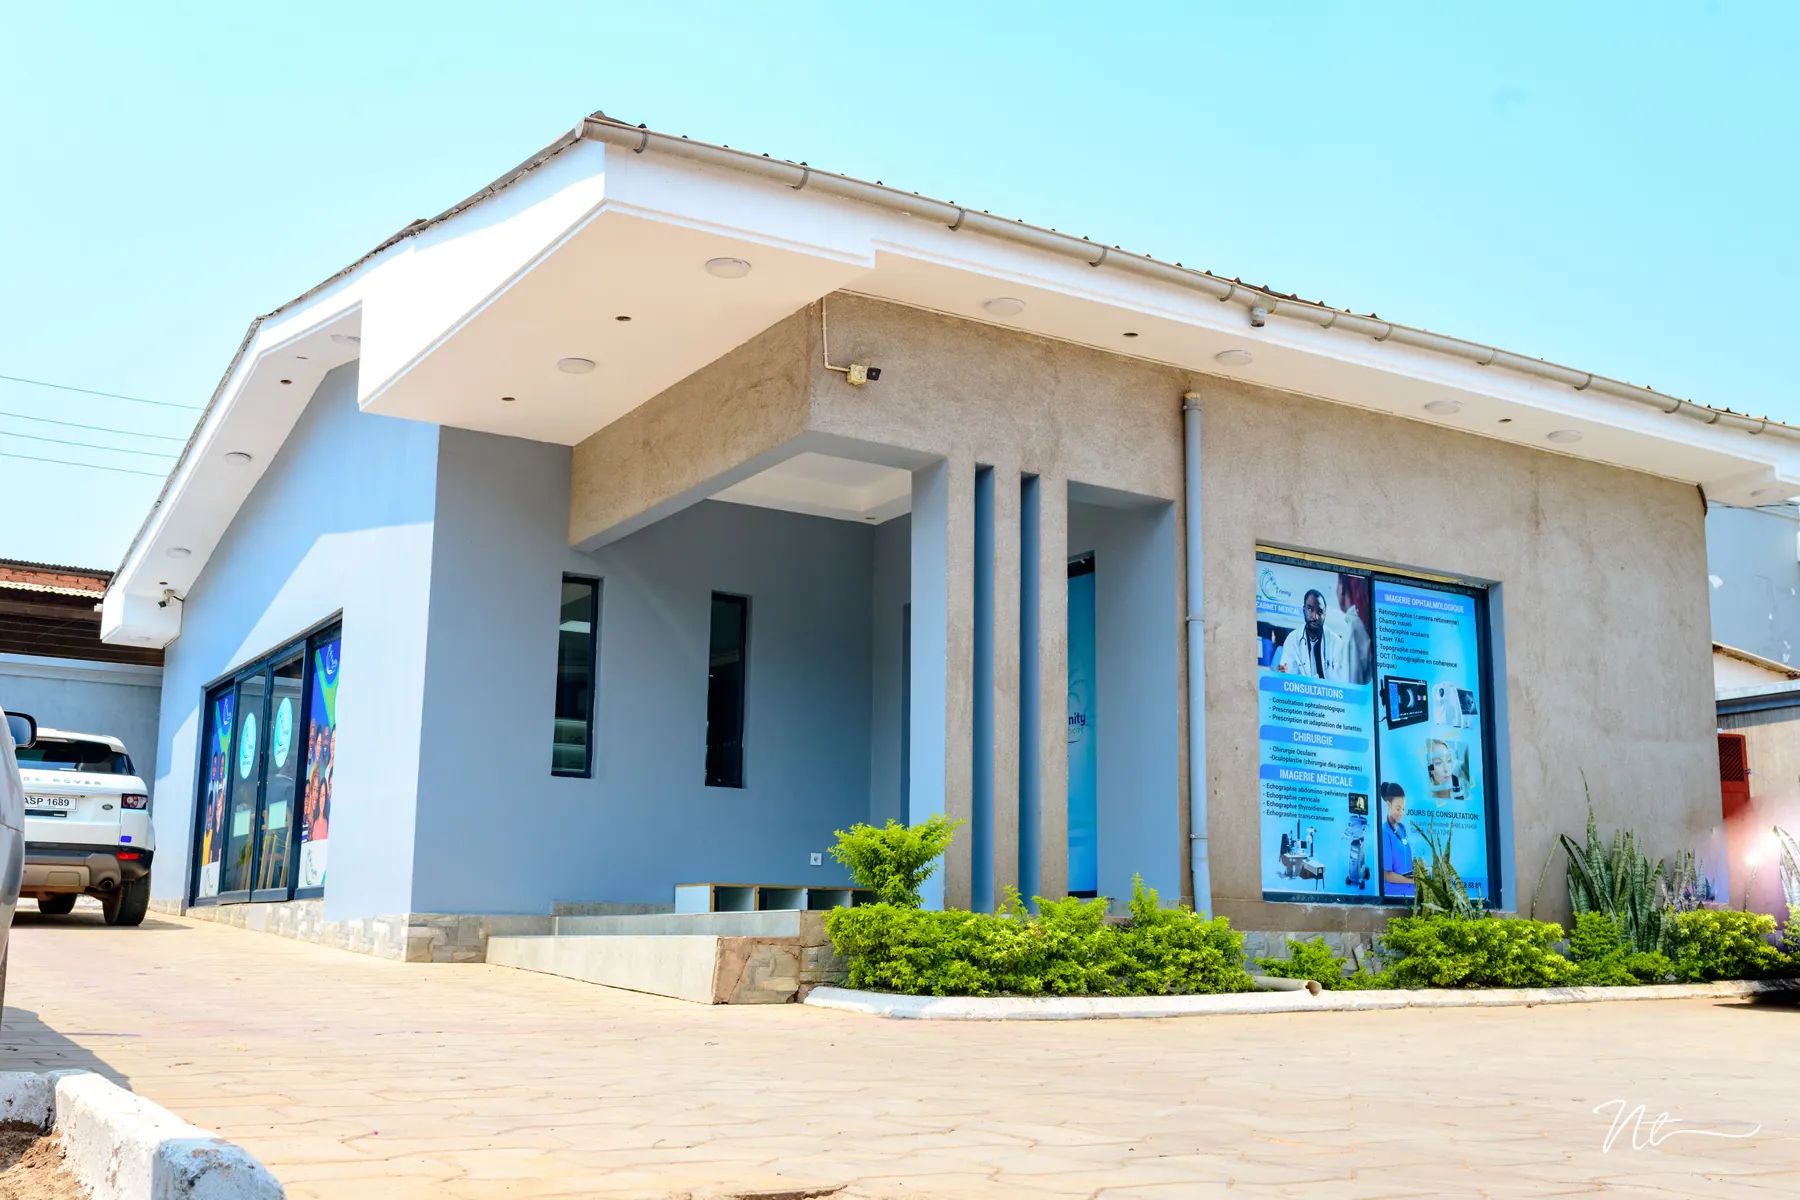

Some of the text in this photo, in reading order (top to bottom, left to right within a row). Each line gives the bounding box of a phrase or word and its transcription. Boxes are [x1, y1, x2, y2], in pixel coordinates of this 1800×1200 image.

[1256, 601, 1277, 611] CABINET
[1384, 594, 1464, 613] IMAGERIE OPHTALMOLOGIQUE
[1379, 617, 1396, 626] Champ
[1379, 626, 1429, 638] Echographie oculaire
[1380, 652, 1390, 660] OCT
[1391, 654, 1425, 664] (Tomographie
[1283, 681, 1344, 699] CONSULTATIONS
[1272, 697, 1345, 713] Consultation ophtalmologique
[1272, 706, 1325, 718] Prescription médicale
[1068, 712, 1086, 726] nity
[1272, 714, 1302, 723] Prescription
[1309, 720, 1335, 729] adaptation
[1342, 724, 1362, 732] lunettes
[1293, 732, 1333, 746] CHIRURGIE
[1272, 746, 1316, 757] Chirurgie Oculaire
[1280, 768, 1353, 787] IMAGERIE MÉDICALE
[1266, 783, 1297, 792] Echographie
[46, 798, 70, 806] 1689
[1266, 792, 1297, 801] Echographie
[1266, 801, 1297, 810] Echographie
[1266, 810, 1297, 819] Echographie
[1436, 811, 1480, 820] CONSULTATION:
